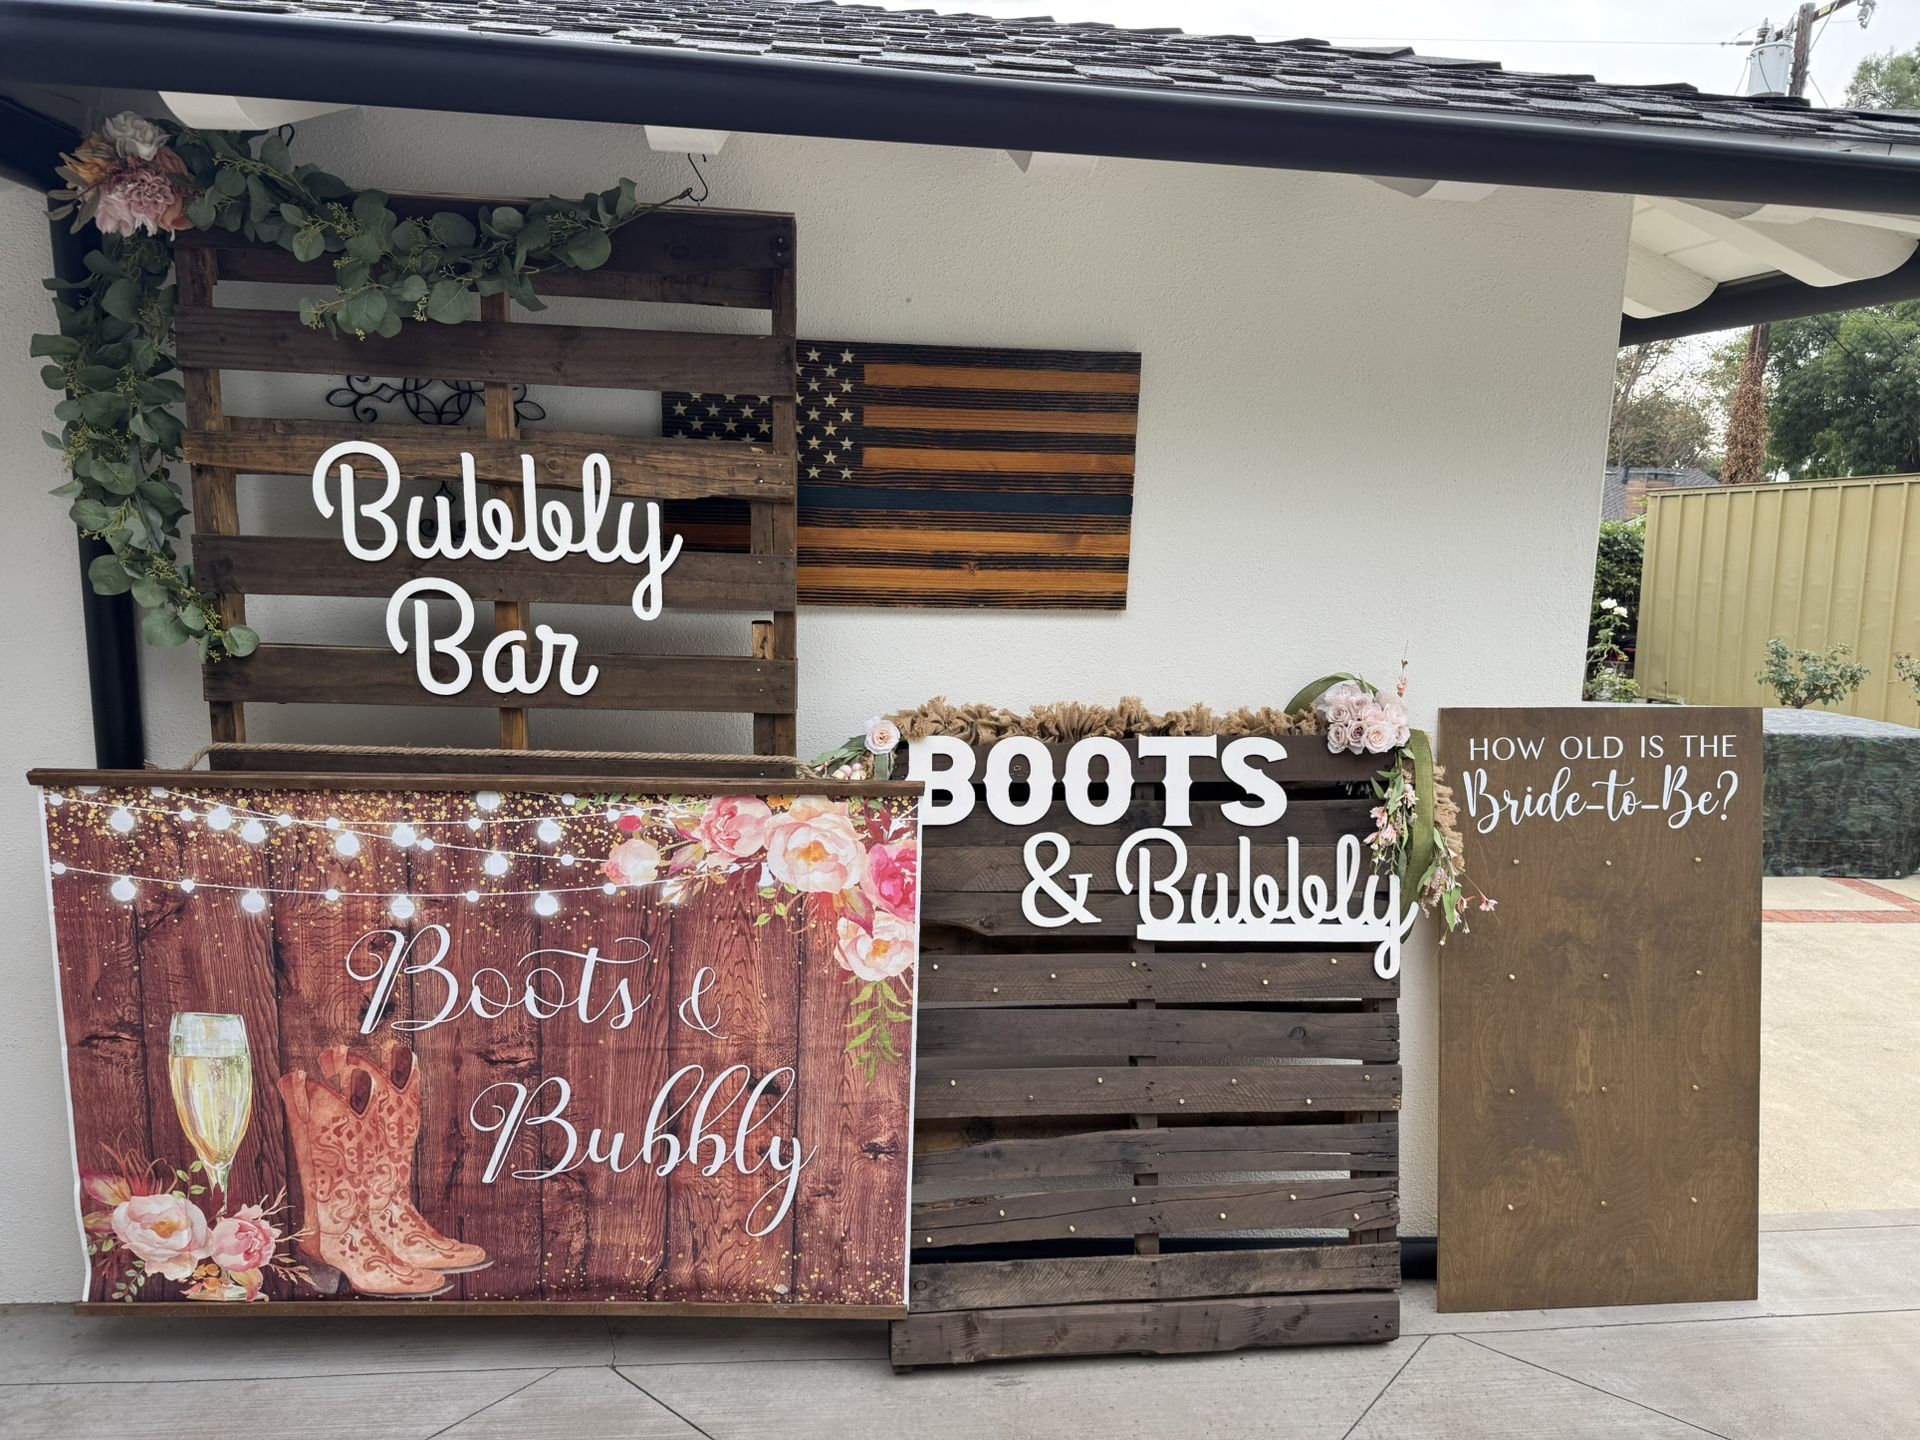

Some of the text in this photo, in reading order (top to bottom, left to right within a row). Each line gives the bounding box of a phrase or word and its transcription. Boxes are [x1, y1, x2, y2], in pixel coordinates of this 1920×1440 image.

[312, 440, 683, 621] Bubbly
[386, 577, 599, 696] Bar
[905, 735, 1289, 827] BOOTS
[1462, 764, 1739, 834] Bride-to-Be?
[1469, 734, 1738, 761] HOW OLD IS THE
[1021, 828, 1419, 980] & Bubbly
[346, 924, 728, 1040] Boots &
[469, 1064, 818, 1237] Bubbly
